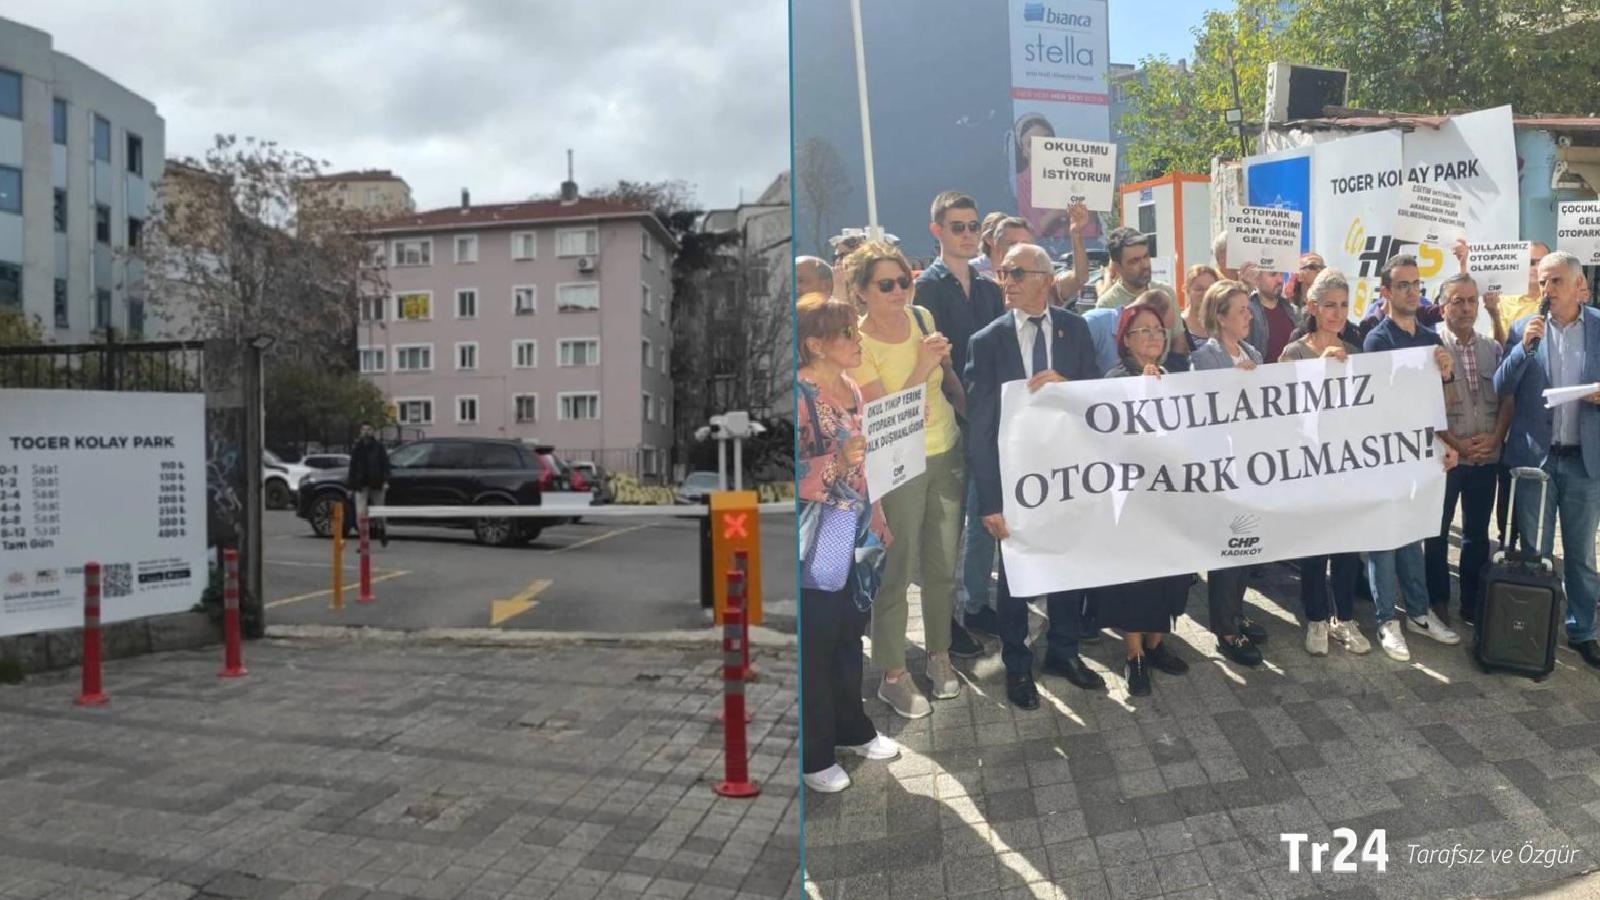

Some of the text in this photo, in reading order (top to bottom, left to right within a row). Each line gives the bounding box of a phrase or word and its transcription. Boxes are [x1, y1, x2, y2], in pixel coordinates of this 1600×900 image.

[1047, 8, 1092, 28] bianca
[1025, 33, 1094, 67] stella
[1044, 142, 1109, 156] OKULUMU
[1063, 156, 1094, 168] GERİ
[1043, 168, 1111, 183] İSTİYORUM
[1331, 173, 1374, 195] TOGER
[1434, 158, 1480, 182] PARK
[1242, 208, 1290, 219] OTOPARK
[1561, 205, 1600, 216] ÇOCUKL
[1229, 216, 1262, 225] DEĞİL
[1236, 227, 1266, 235] RANT
[1470, 254, 1517, 262] OTOPARK
[1471, 264, 1519, 272] OLMASIN!
[1085, 374, 1375, 434] OKULLARIMIZ
[868, 415, 897, 434] OTOPARK
[10, 436, 174, 449] TOGER KOLAY PARK
[0, 465, 18, 475] 0-1
[1014, 425, 1436, 510] OTOPARK OLMASIN!
[2, 541, 27, 550] Tam
[1228, 537, 1260, 548] CHP
